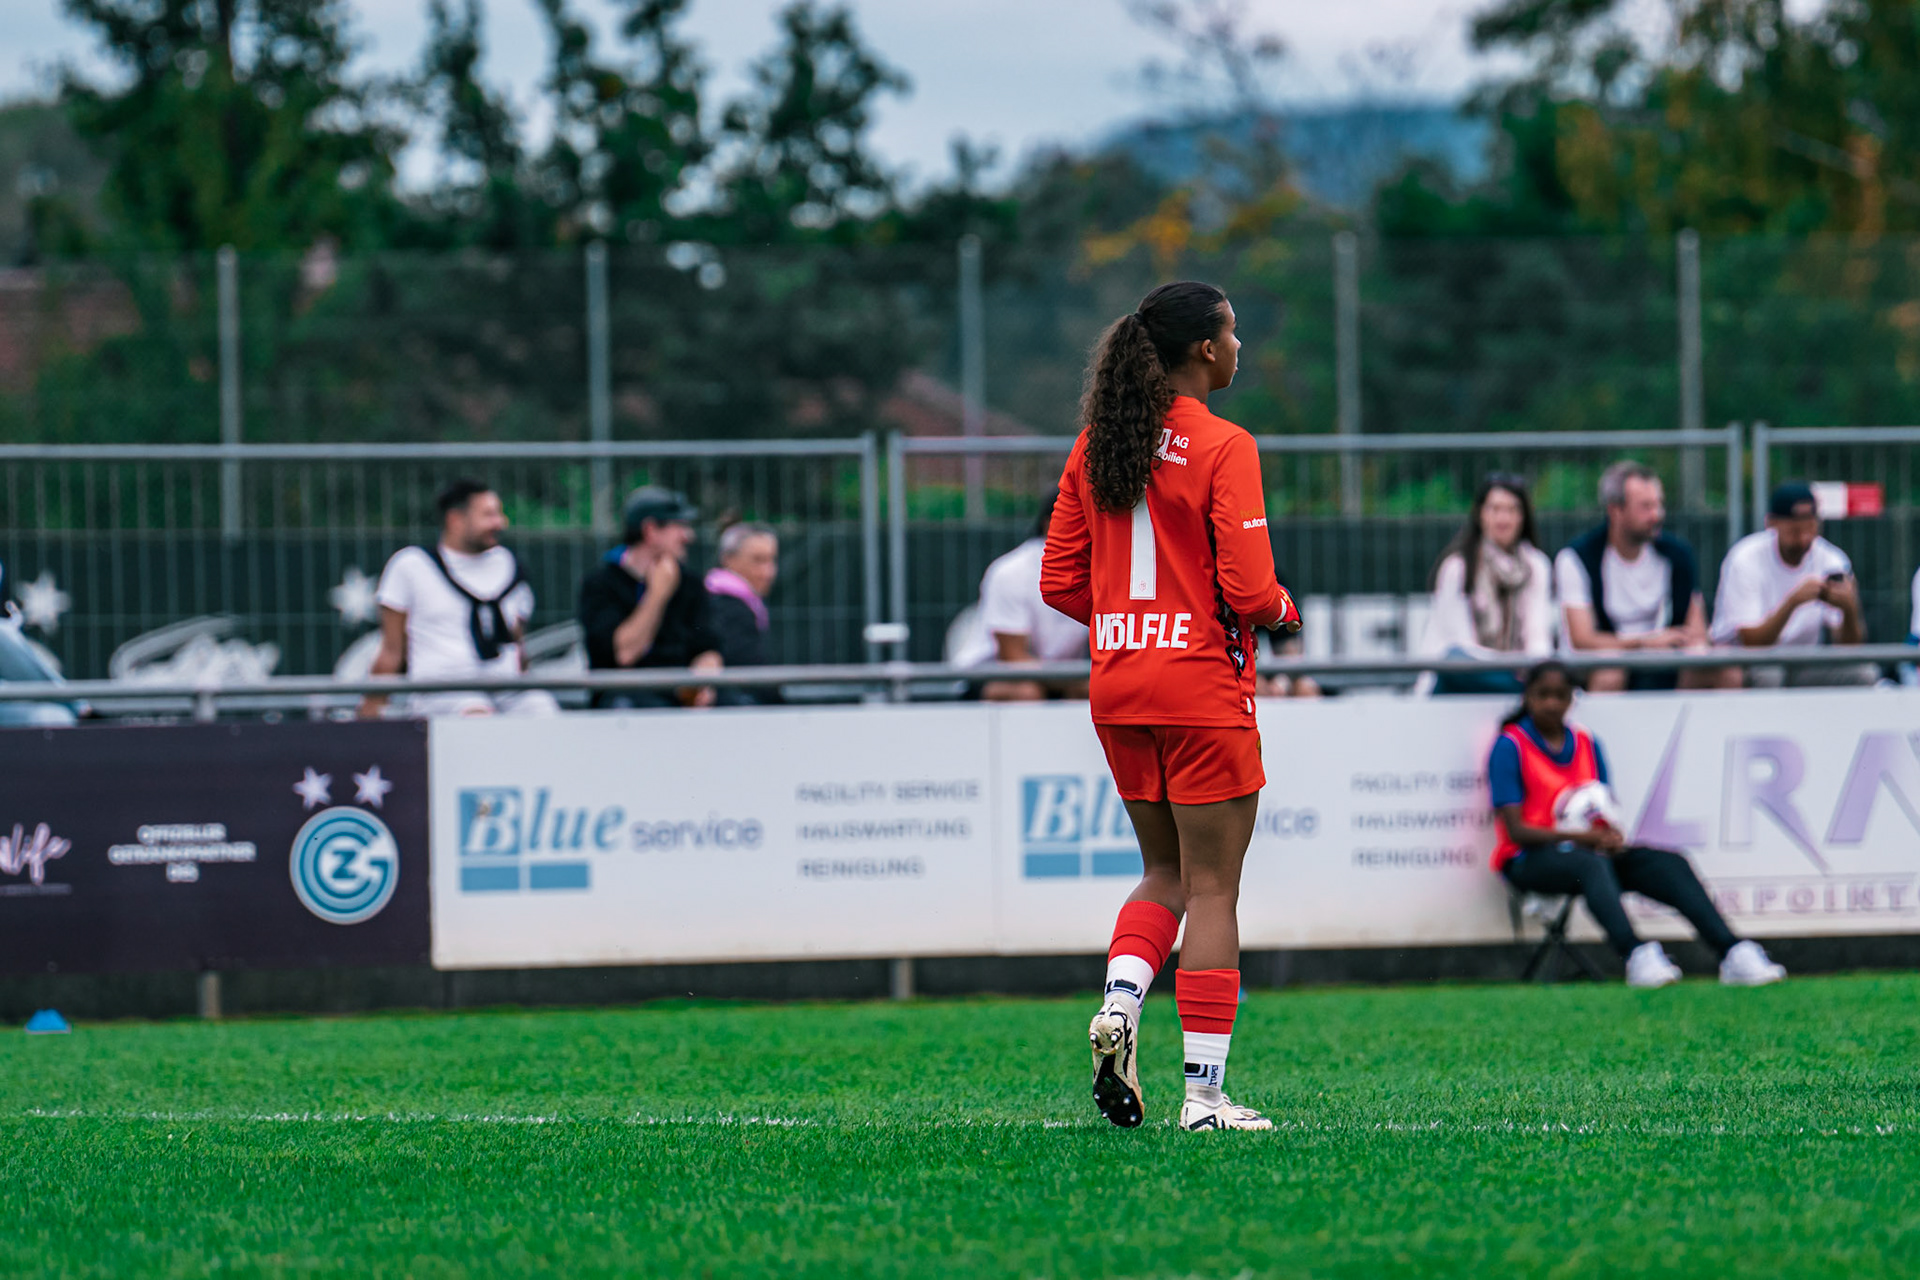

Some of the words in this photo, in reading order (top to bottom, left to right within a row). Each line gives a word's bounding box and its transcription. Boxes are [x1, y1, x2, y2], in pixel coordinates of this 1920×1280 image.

[1171, 434, 1190, 449] AG
[1129, 482, 1157, 600] 1
[1095, 613, 1192, 650] WÖLFLE
[796, 782, 886, 804] FACILITY
[892, 779, 981, 803] SERVICE
[459, 787, 626, 851] Blue
[630, 813, 764, 852] service
